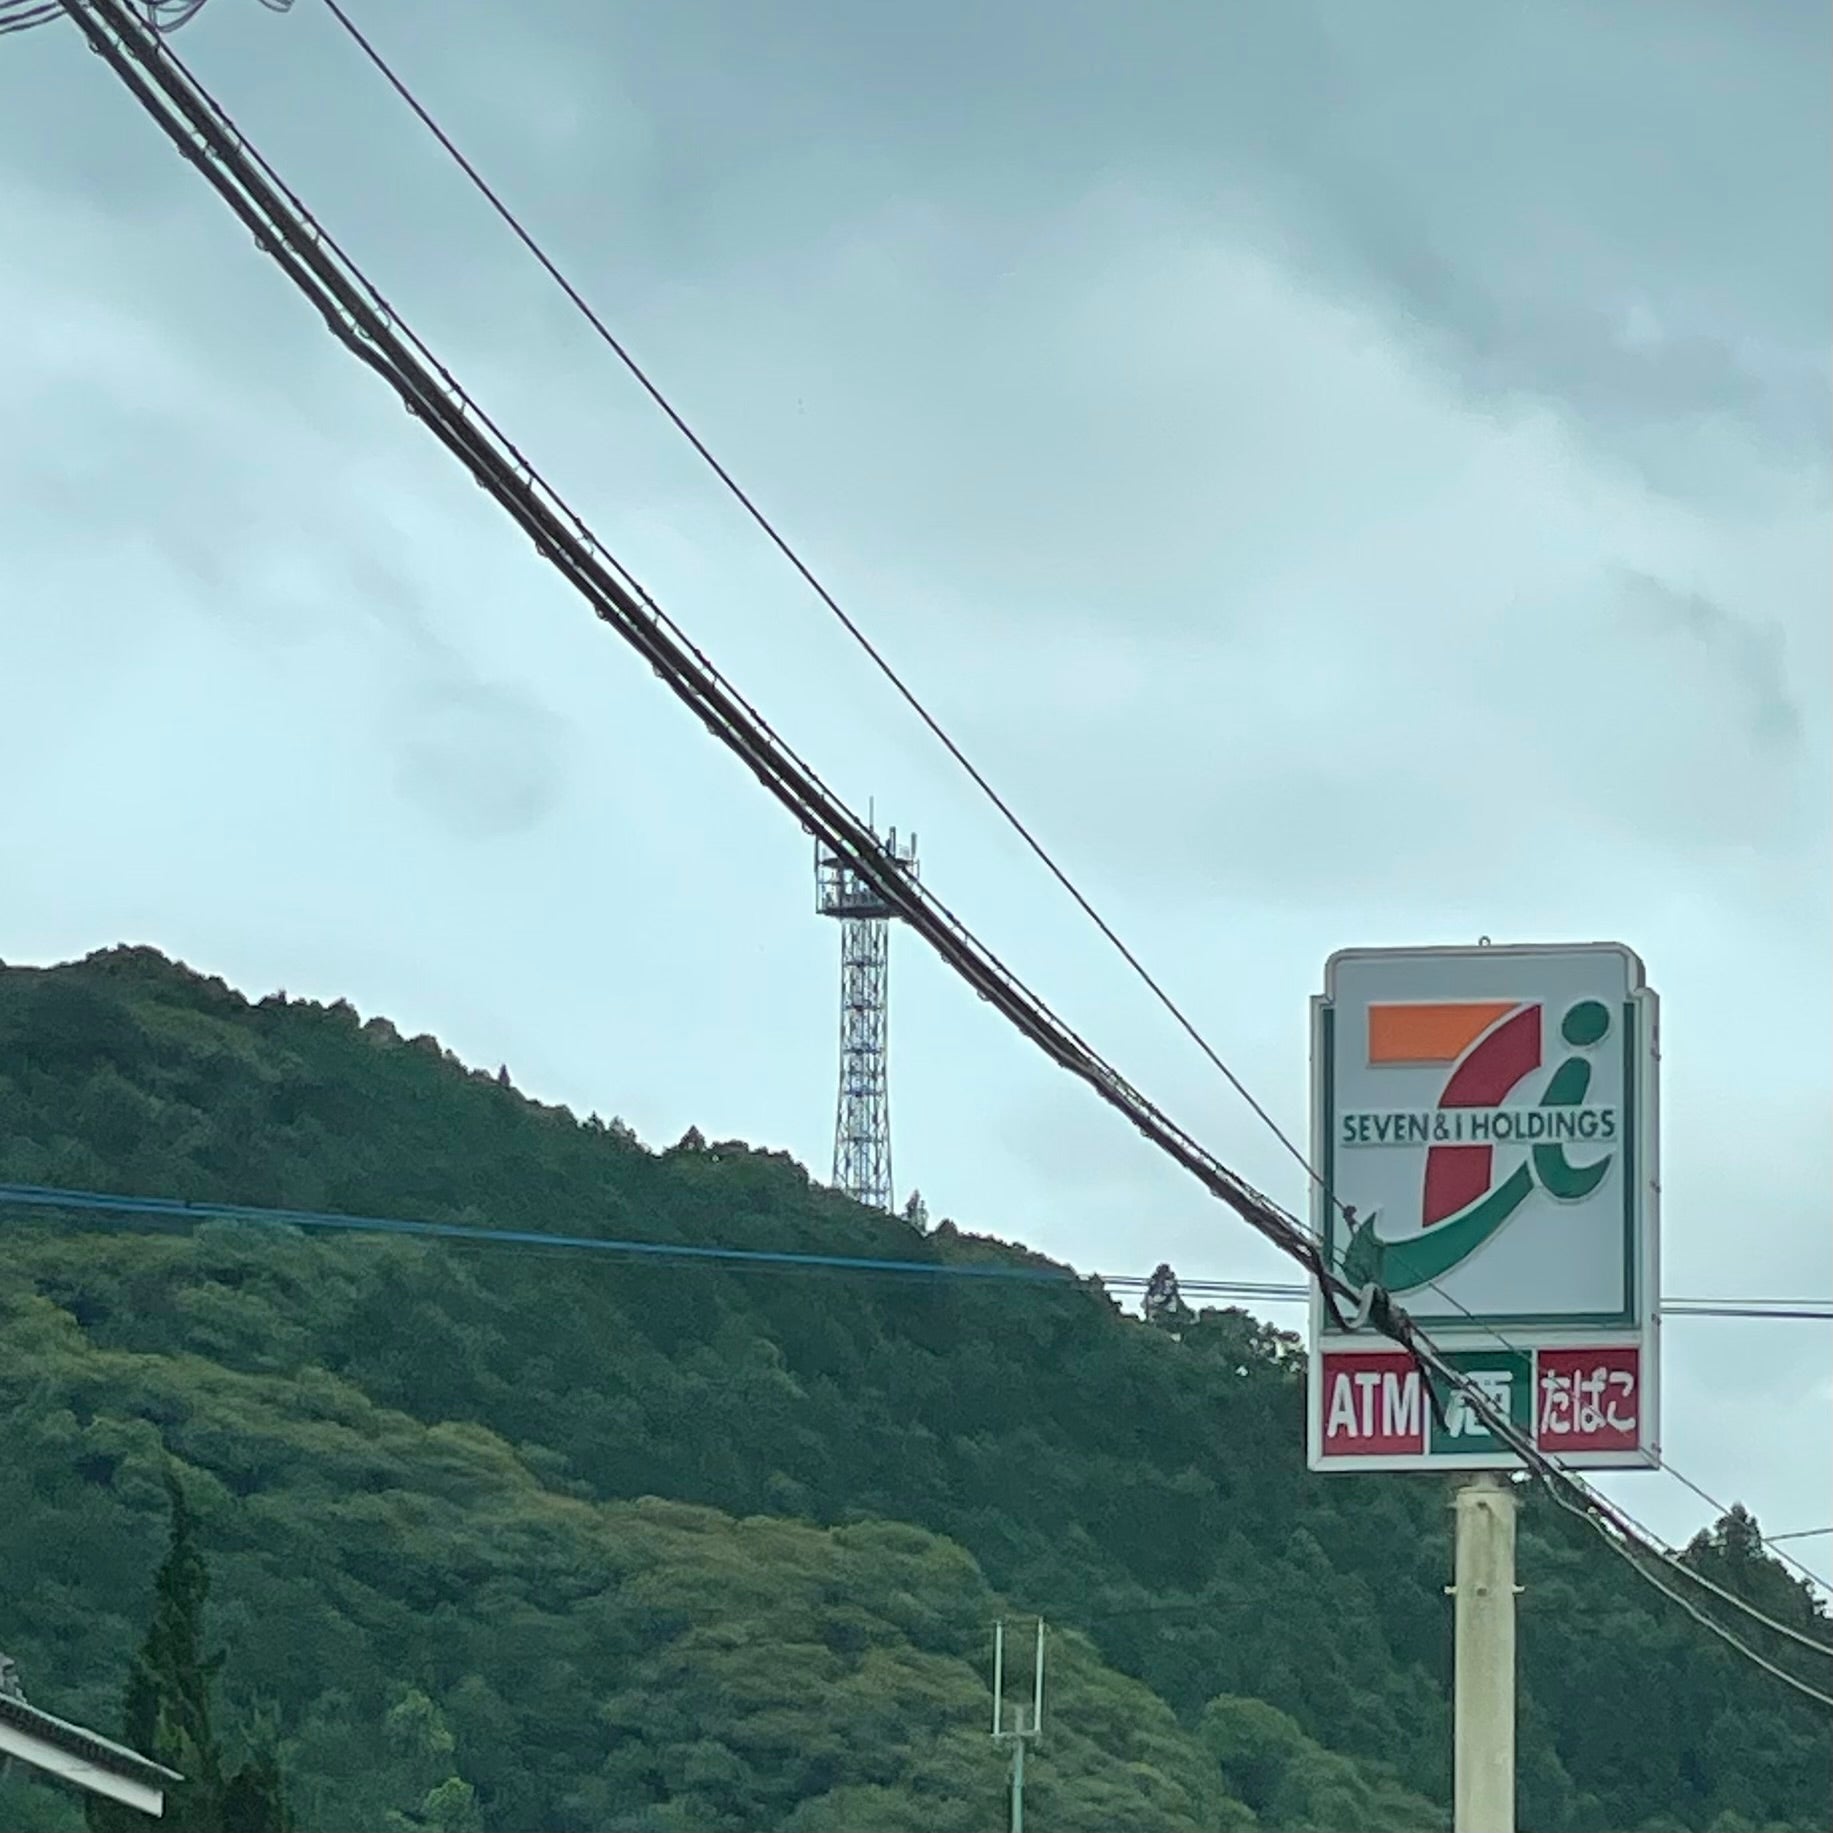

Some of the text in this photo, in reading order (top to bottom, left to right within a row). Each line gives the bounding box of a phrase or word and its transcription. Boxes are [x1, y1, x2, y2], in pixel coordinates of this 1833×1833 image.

[1472, 1109, 1616, 1139] HOLDINGS
[1327, 1371, 1420, 1438] ATM
[1541, 1367, 1636, 1435] たばこ
